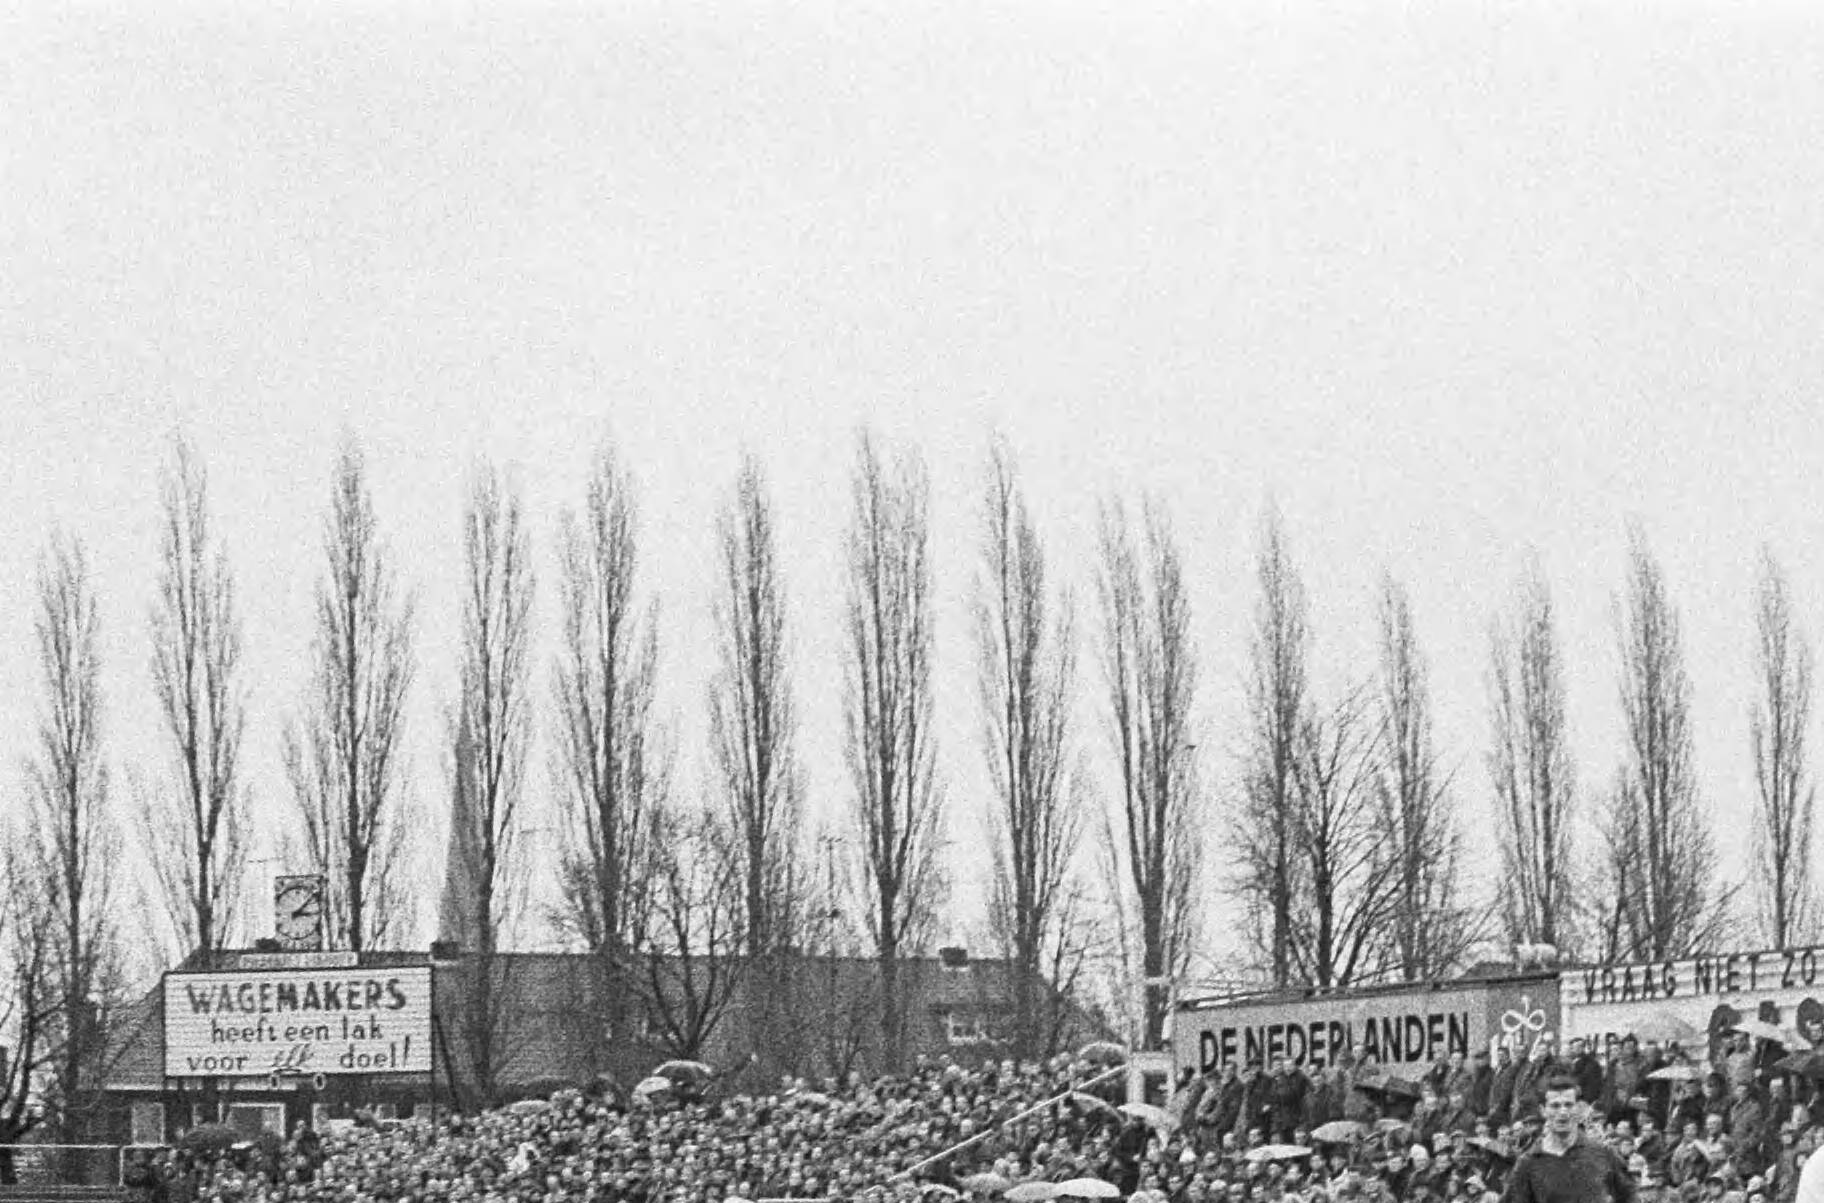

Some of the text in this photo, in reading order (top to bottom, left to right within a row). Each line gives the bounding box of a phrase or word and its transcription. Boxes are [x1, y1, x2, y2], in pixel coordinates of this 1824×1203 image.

[1585, 960, 1677, 1003] VRAAG
[1695, 951, 1760, 995] NIET
[1780, 949, 1817, 988] ZO
[185, 977, 406, 1014] WAGEMAKERS
[210, 1014, 385, 1043] heeft een lak
[186, 1054, 249, 1072] voor
[339, 1035, 411, 1069] doel!
